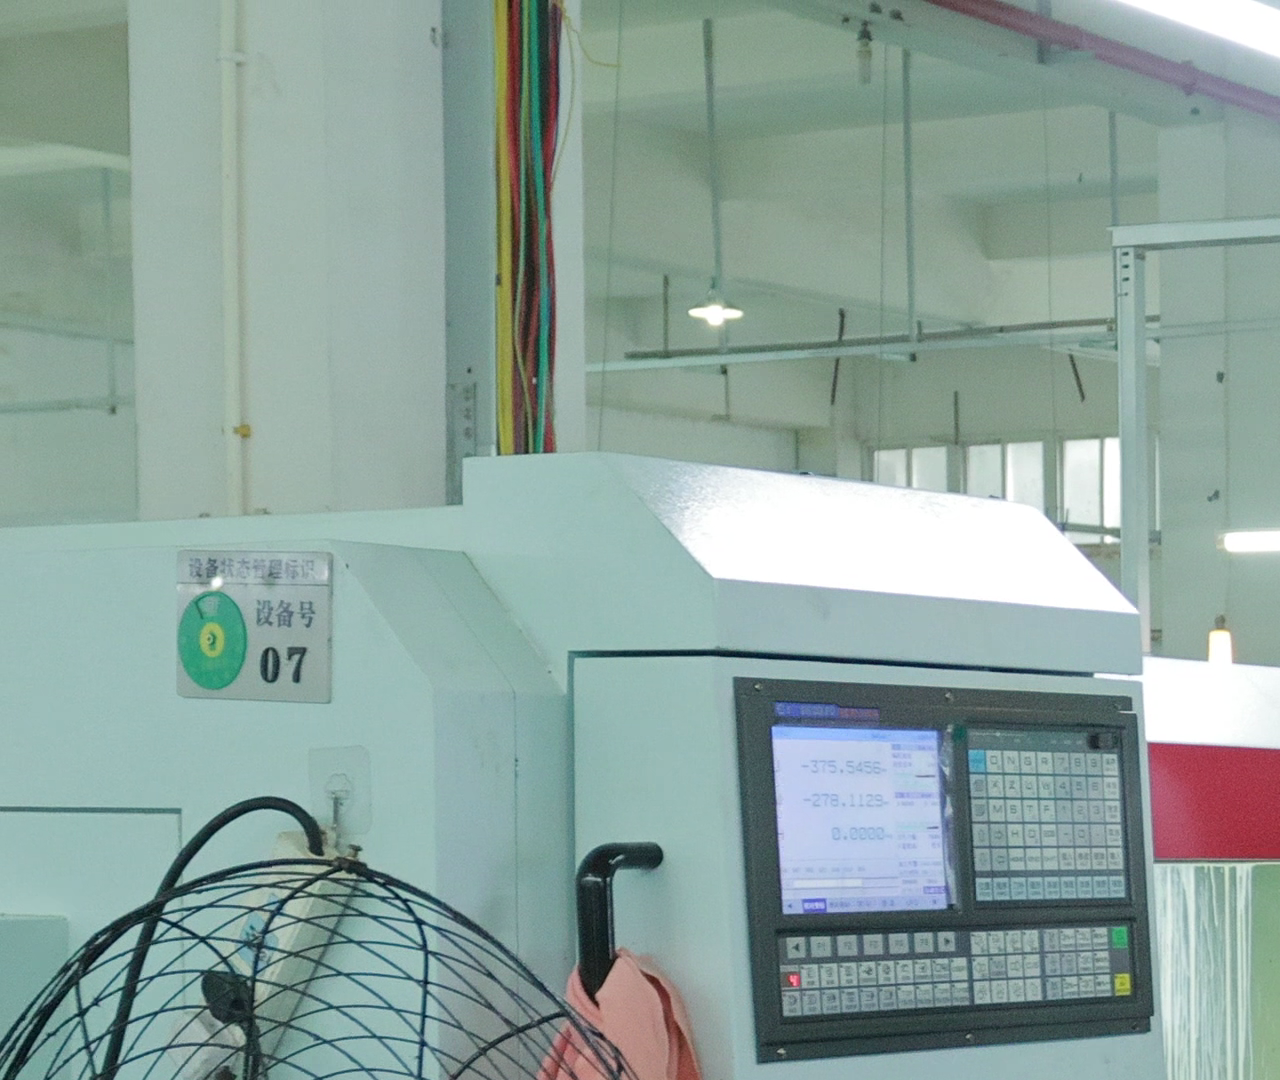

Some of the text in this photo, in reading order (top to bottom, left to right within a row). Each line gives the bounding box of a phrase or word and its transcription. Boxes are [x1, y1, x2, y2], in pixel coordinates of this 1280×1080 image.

[188, 557, 316, 579] 设备状态管理标识
[255, 600, 317, 629] 设备号
[260, 646, 308, 684] 07
